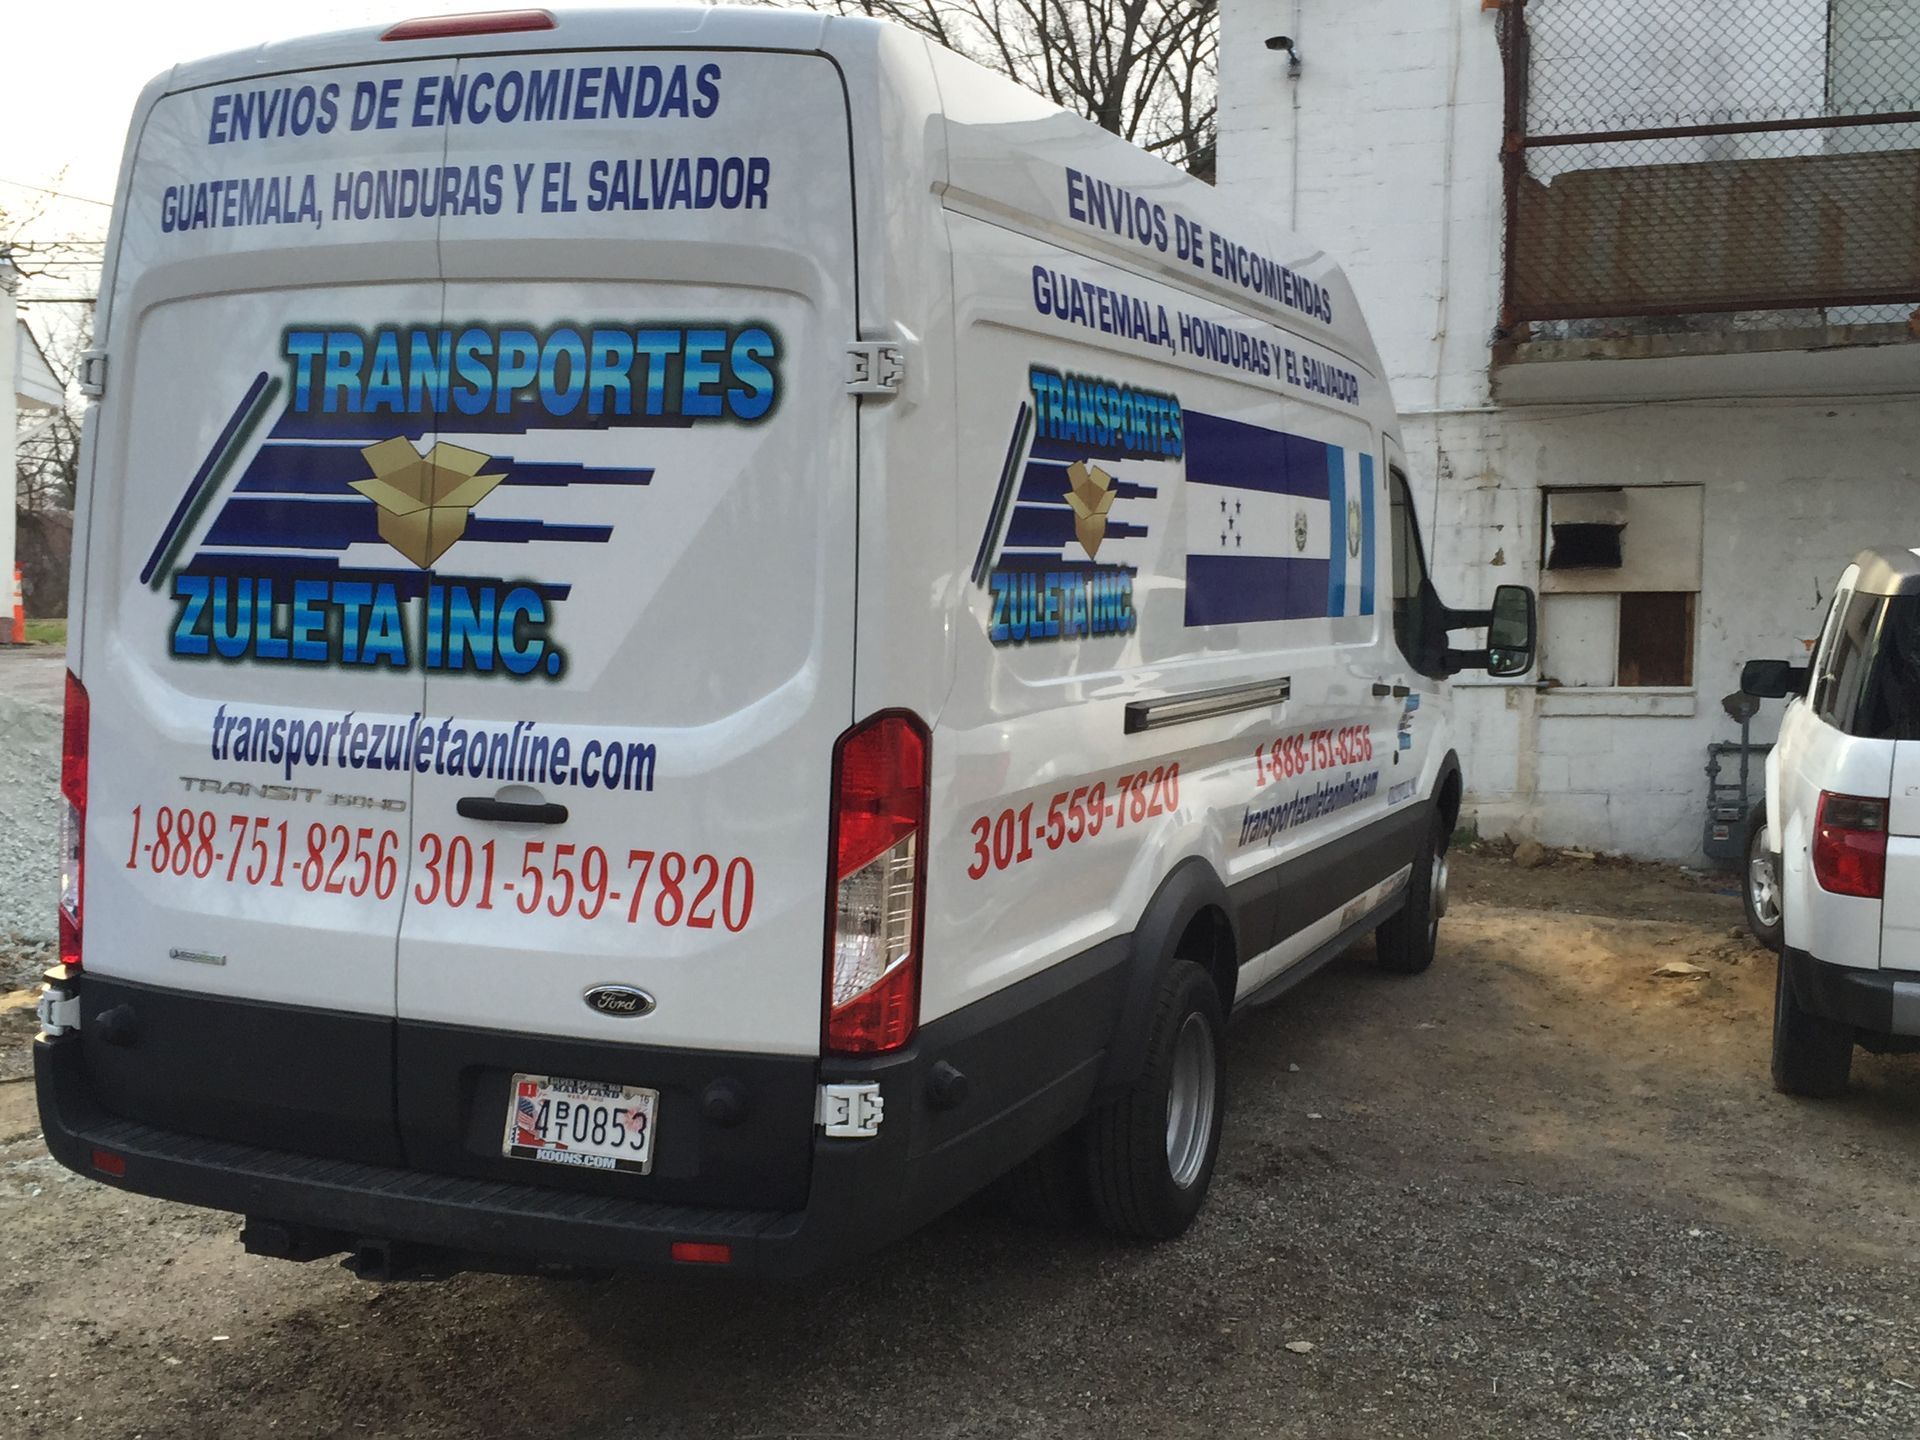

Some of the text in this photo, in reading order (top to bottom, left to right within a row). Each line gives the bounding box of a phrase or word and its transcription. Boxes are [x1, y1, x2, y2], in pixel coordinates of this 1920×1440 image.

[208, 63, 722, 145] ENVIOS DE ENCOMIENDAS
[161, 156, 772, 233] GUATEMALA, HONDURAS Y EL SALVADOR
[1066, 167, 1333, 325] ENVIOS DE ENCOMIENDAS
[286, 328, 778, 420] TRANSPORTES
[1031, 265, 1360, 407] GUATEMALA, HONDURAS Y EL SALVADOR
[1030, 372, 1184, 459] TRANSPORTES
[171, 575, 562, 675] ZULETA INC.
[988, 571, 1136, 643] ZULETA INC.
[179, 776, 322, 804] TRANSIT
[211, 703, 657, 792] transportezuletaonline.com
[1254, 724, 1374, 787] 1-888-751-8256
[967, 762, 1180, 880] 301-559-7820
[125, 804, 756, 933] 1-888-751-8256 301-559-7820
[597, 990, 637, 1012] Ford
[536, 1149, 617, 1170] KOONS.COM
